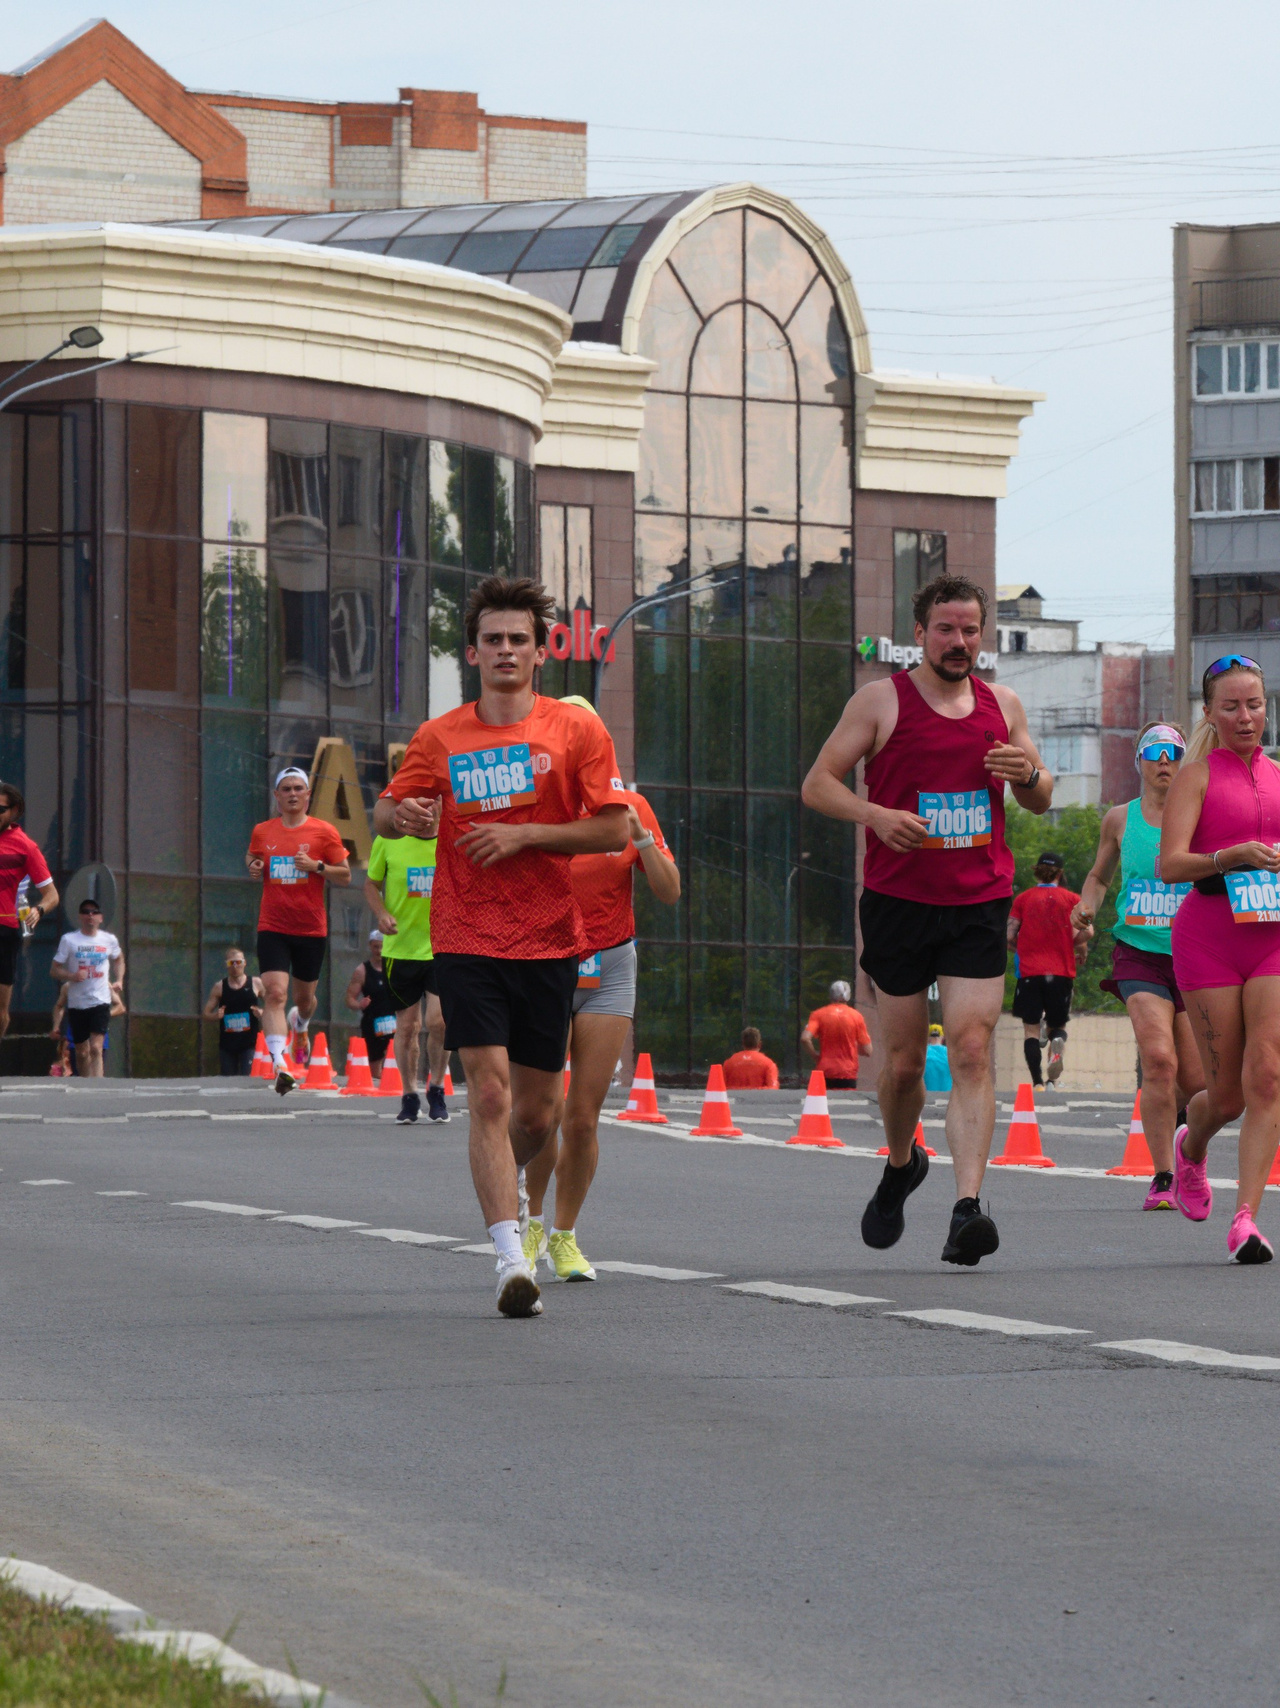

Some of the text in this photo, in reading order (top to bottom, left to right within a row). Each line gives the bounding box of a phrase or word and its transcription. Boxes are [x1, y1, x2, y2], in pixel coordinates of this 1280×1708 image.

[545, 609, 616, 662] olla
[457, 761, 527, 799] 70168
[480, 795, 511, 812] 21.1КМ
[926, 805, 987, 835] 70016
[943, 835, 973, 849] 21.1КМ
[410, 875, 433, 891] 700
